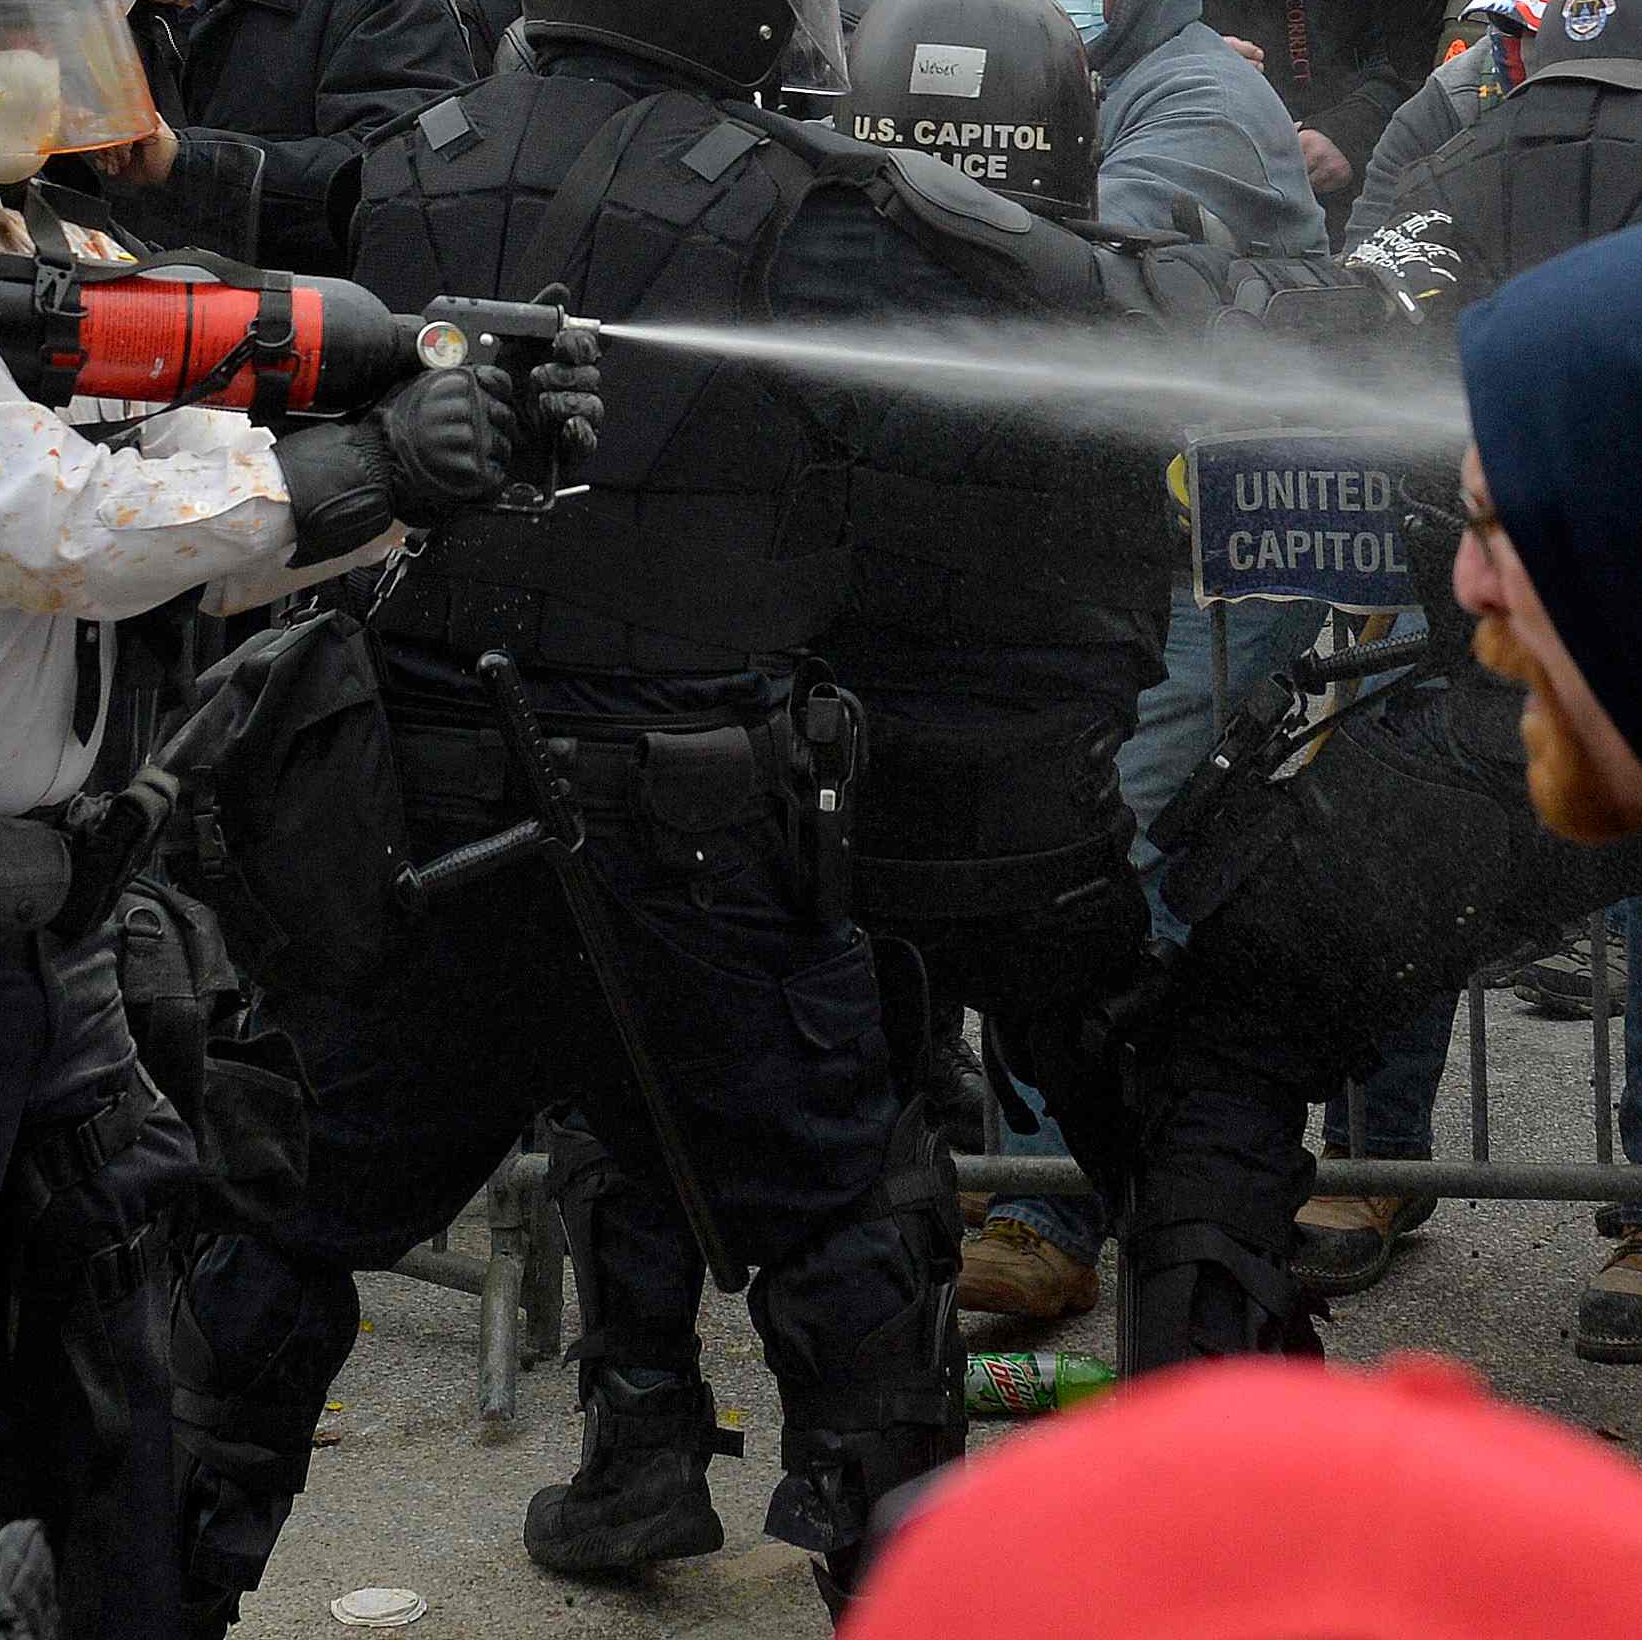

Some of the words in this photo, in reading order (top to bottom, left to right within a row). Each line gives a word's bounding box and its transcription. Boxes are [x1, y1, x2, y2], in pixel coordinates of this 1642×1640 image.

[918, 58, 958, 77] Weber
[854, 116, 903, 143] U.S.
[913, 120, 1052, 151] CAPITOL
[1235, 470, 1392, 511] UNITED
[1228, 529, 1407, 573] CAPITOL
